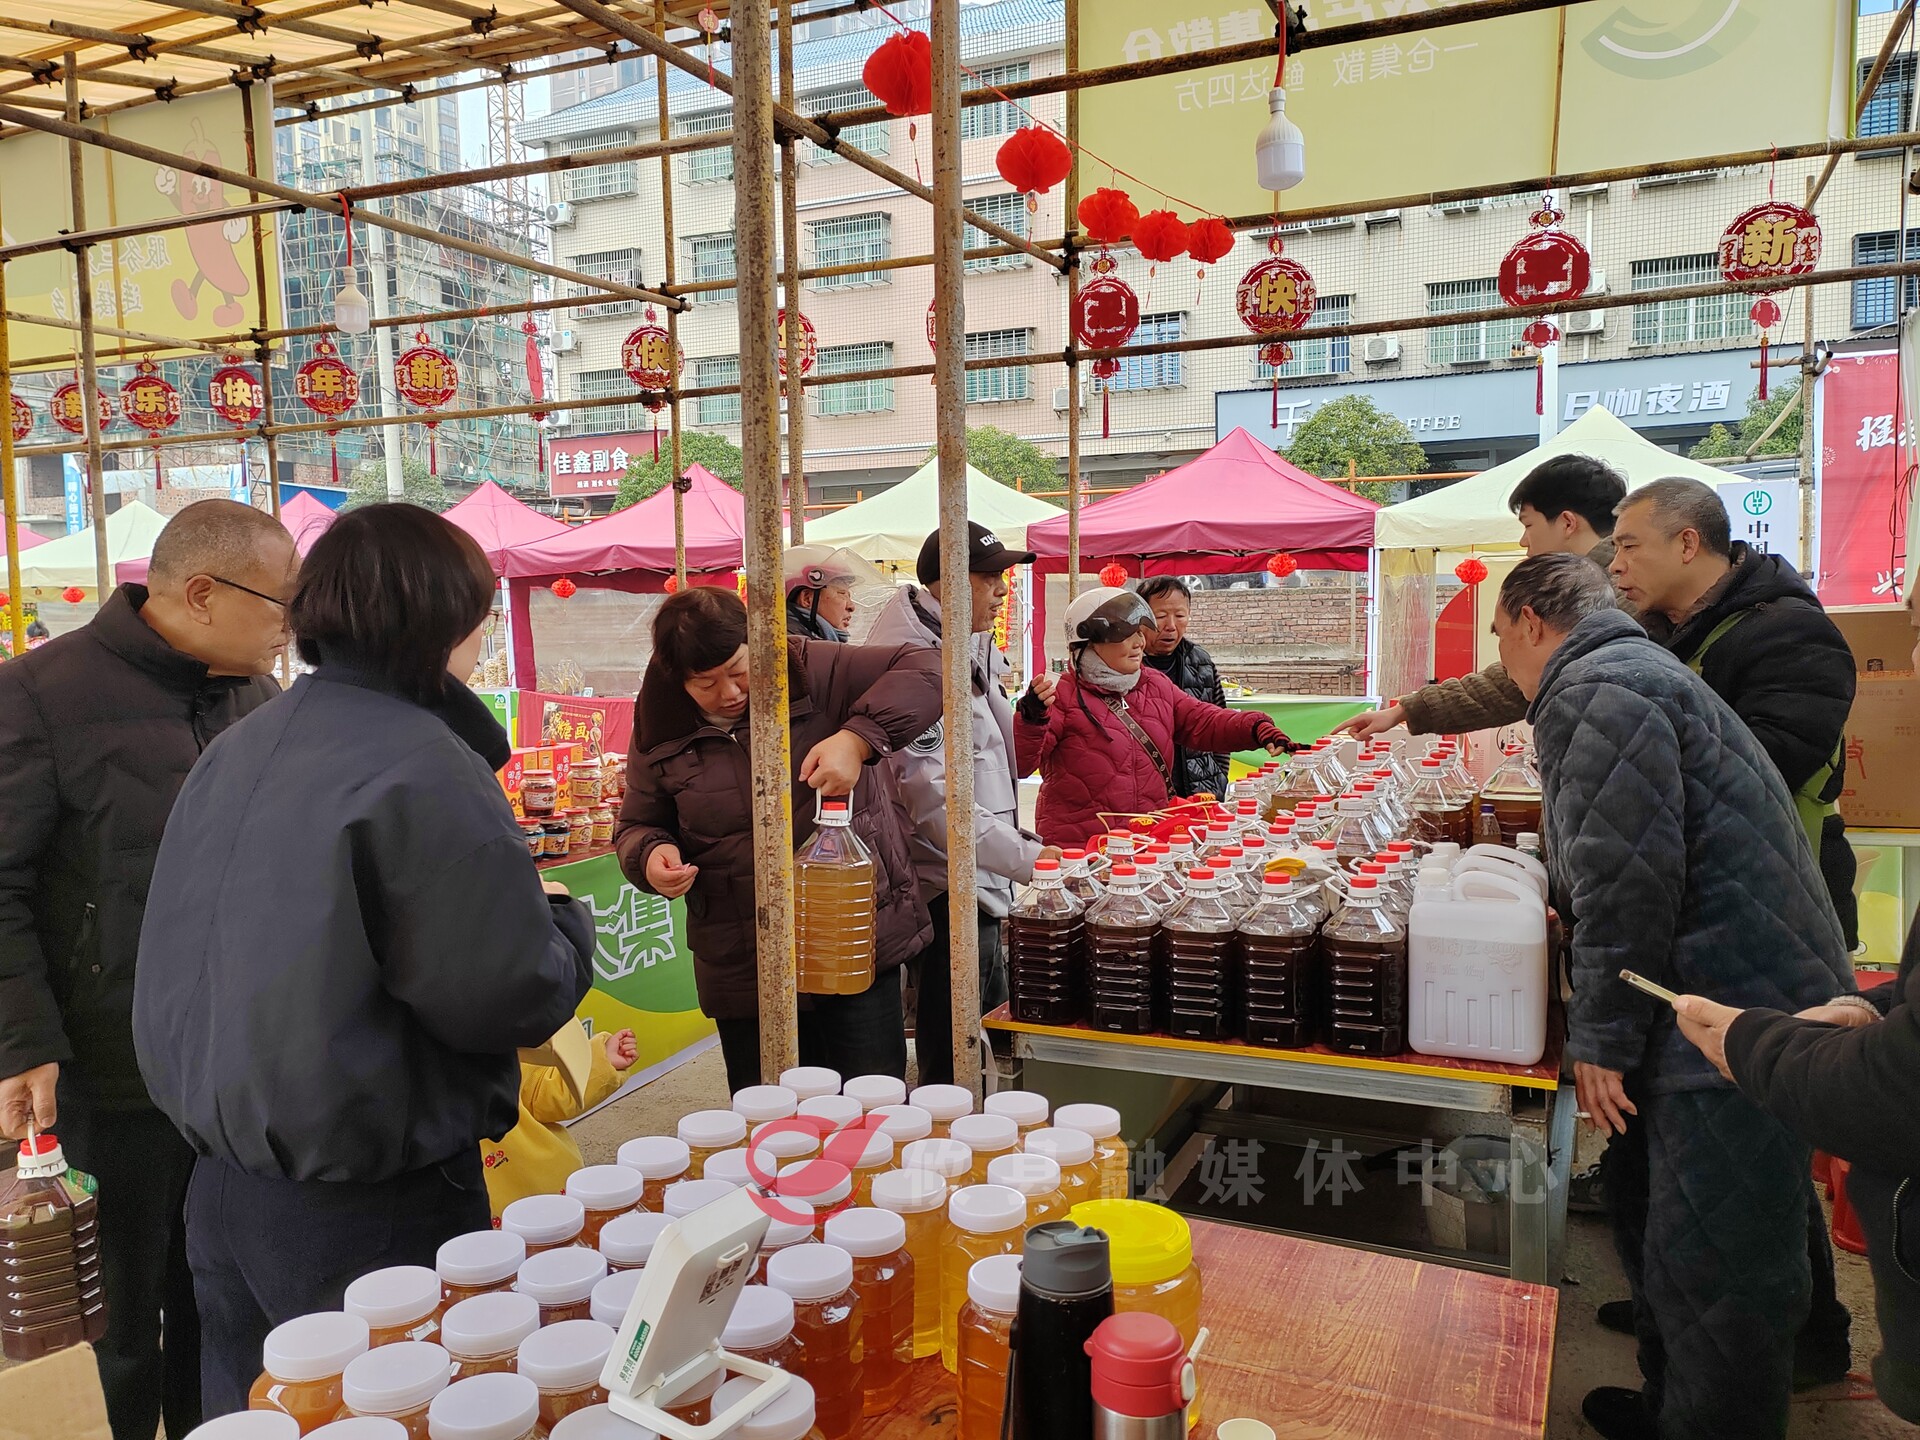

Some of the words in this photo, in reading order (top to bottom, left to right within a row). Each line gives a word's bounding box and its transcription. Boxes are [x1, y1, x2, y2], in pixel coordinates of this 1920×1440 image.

[1741, 218, 1797, 268] 新
[1256, 273, 1297, 314] 快
[637, 336, 671, 371] 快
[311, 367, 344, 398] 年
[410, 356, 445, 390] 新
[136, 385, 167, 413] 乐
[223, 377, 252, 408] 快
[1563, 380, 1732, 421] 日咖夜酒
[1406, 415, 1462, 431] FFEE
[553, 446, 639, 476] 佳鑫副食
